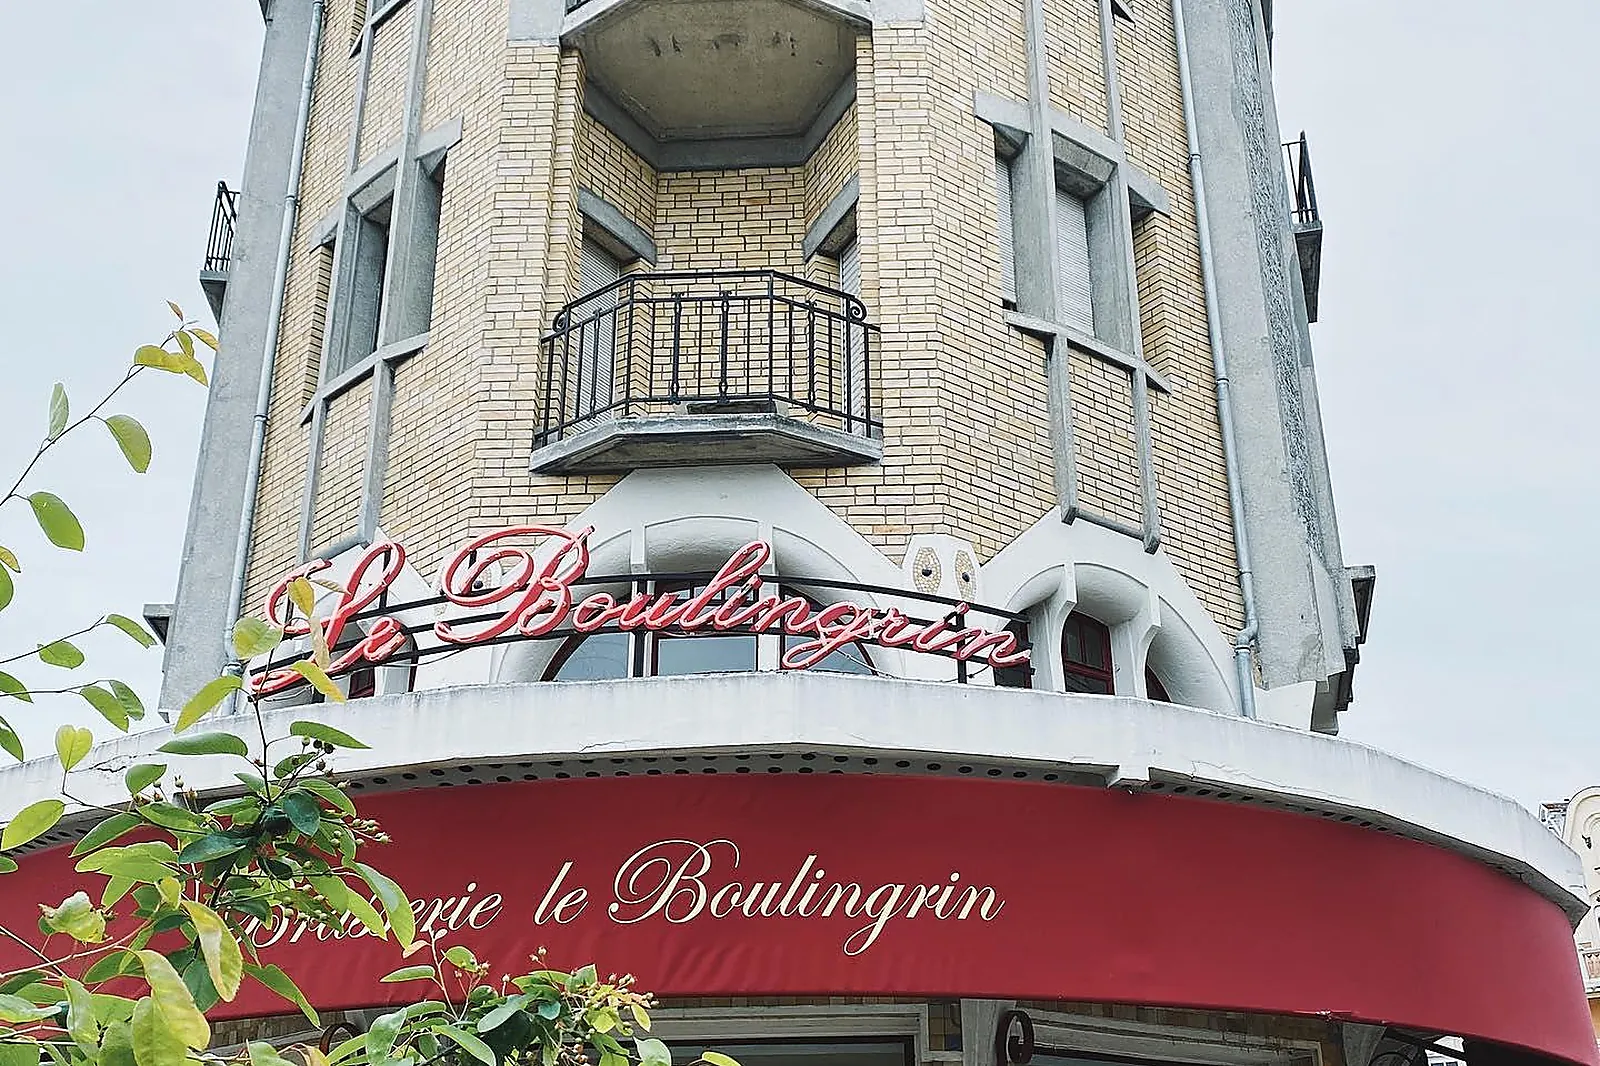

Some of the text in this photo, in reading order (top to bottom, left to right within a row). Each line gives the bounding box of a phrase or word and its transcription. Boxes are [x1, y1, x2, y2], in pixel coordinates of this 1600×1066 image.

[251, 524, 1031, 694] Le Boulingrin
[533, 861, 590, 925] le
[608, 837, 1006, 956] Boulingrin
